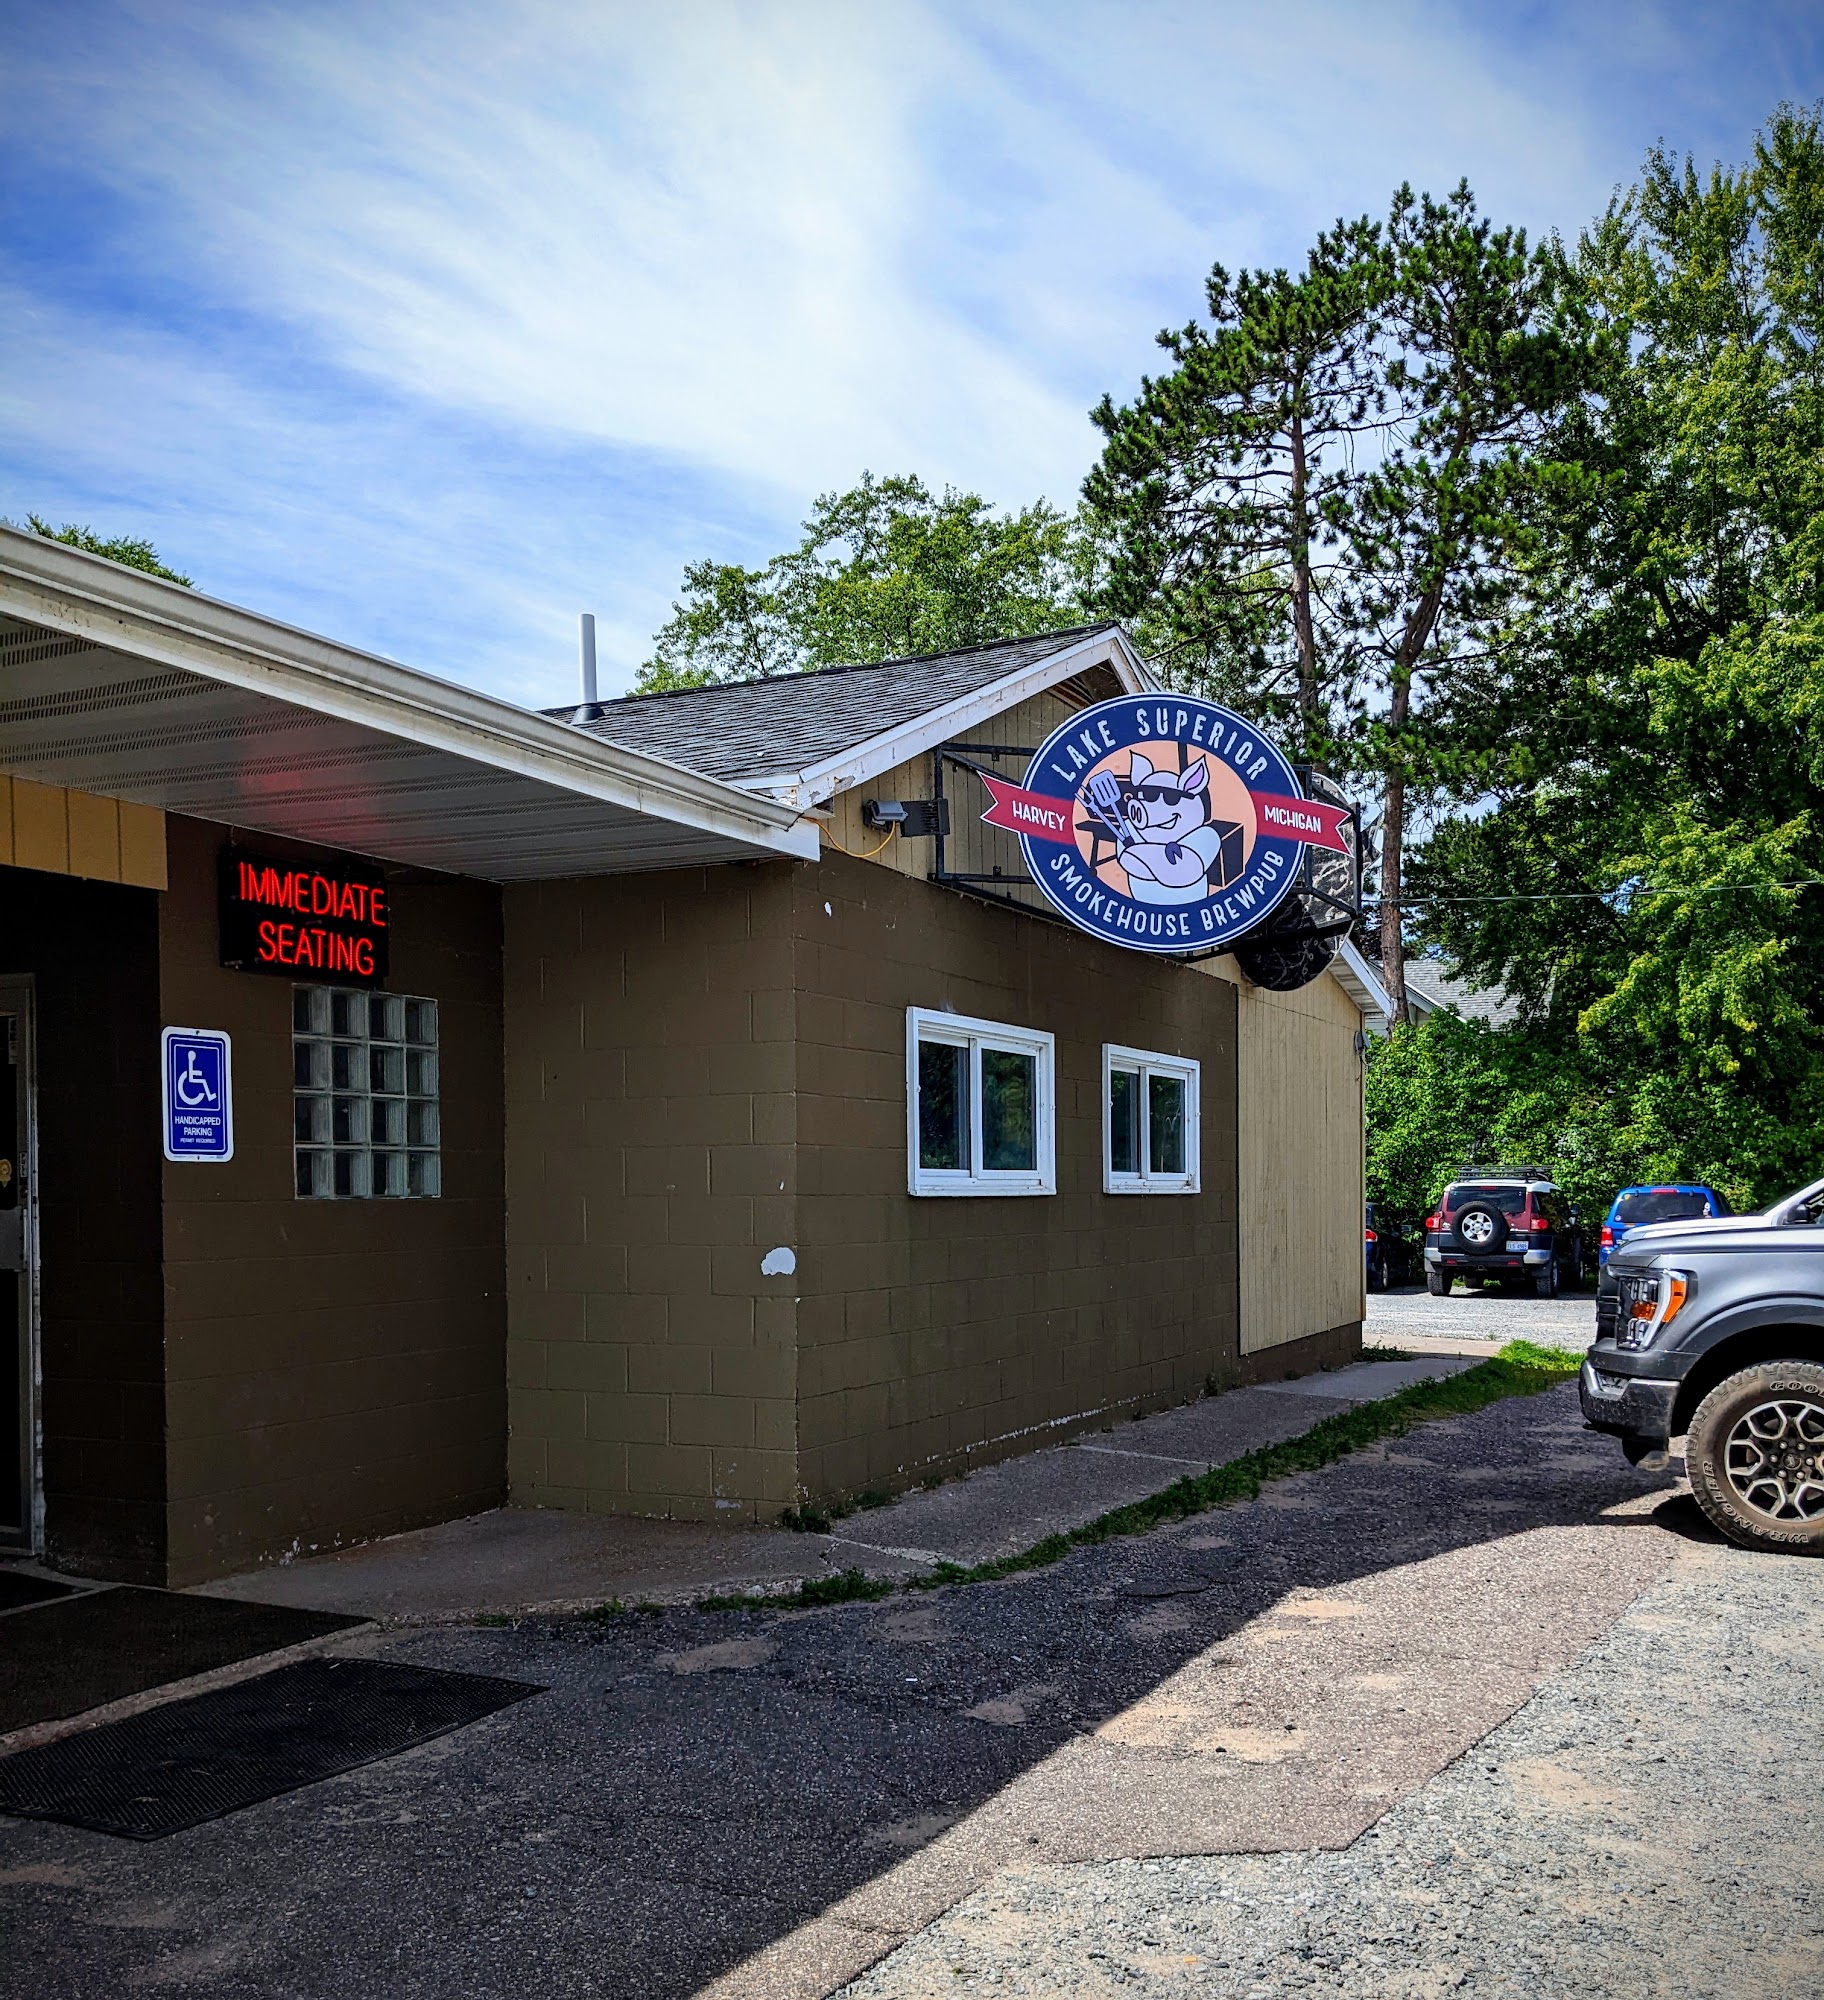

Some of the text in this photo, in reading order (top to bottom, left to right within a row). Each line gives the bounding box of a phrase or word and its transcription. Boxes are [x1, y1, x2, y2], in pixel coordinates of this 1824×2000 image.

[1051, 707, 1268, 783] LAKE SUPERIOR
[1012, 800, 1066, 831] HARVEY
[1264, 804, 1322, 834] MICHIGAN
[239, 862, 386, 926] IMMEDIATE
[1050, 849, 1285, 937] SMOKEHOUSE BREWPUB
[258, 920, 375, 976] SEATING
[175, 1116, 221, 1125] HANDICAPPED
[183, 1127, 212, 1136] PARKING
[1703, 1461, 1809, 1543] WRANGLER
